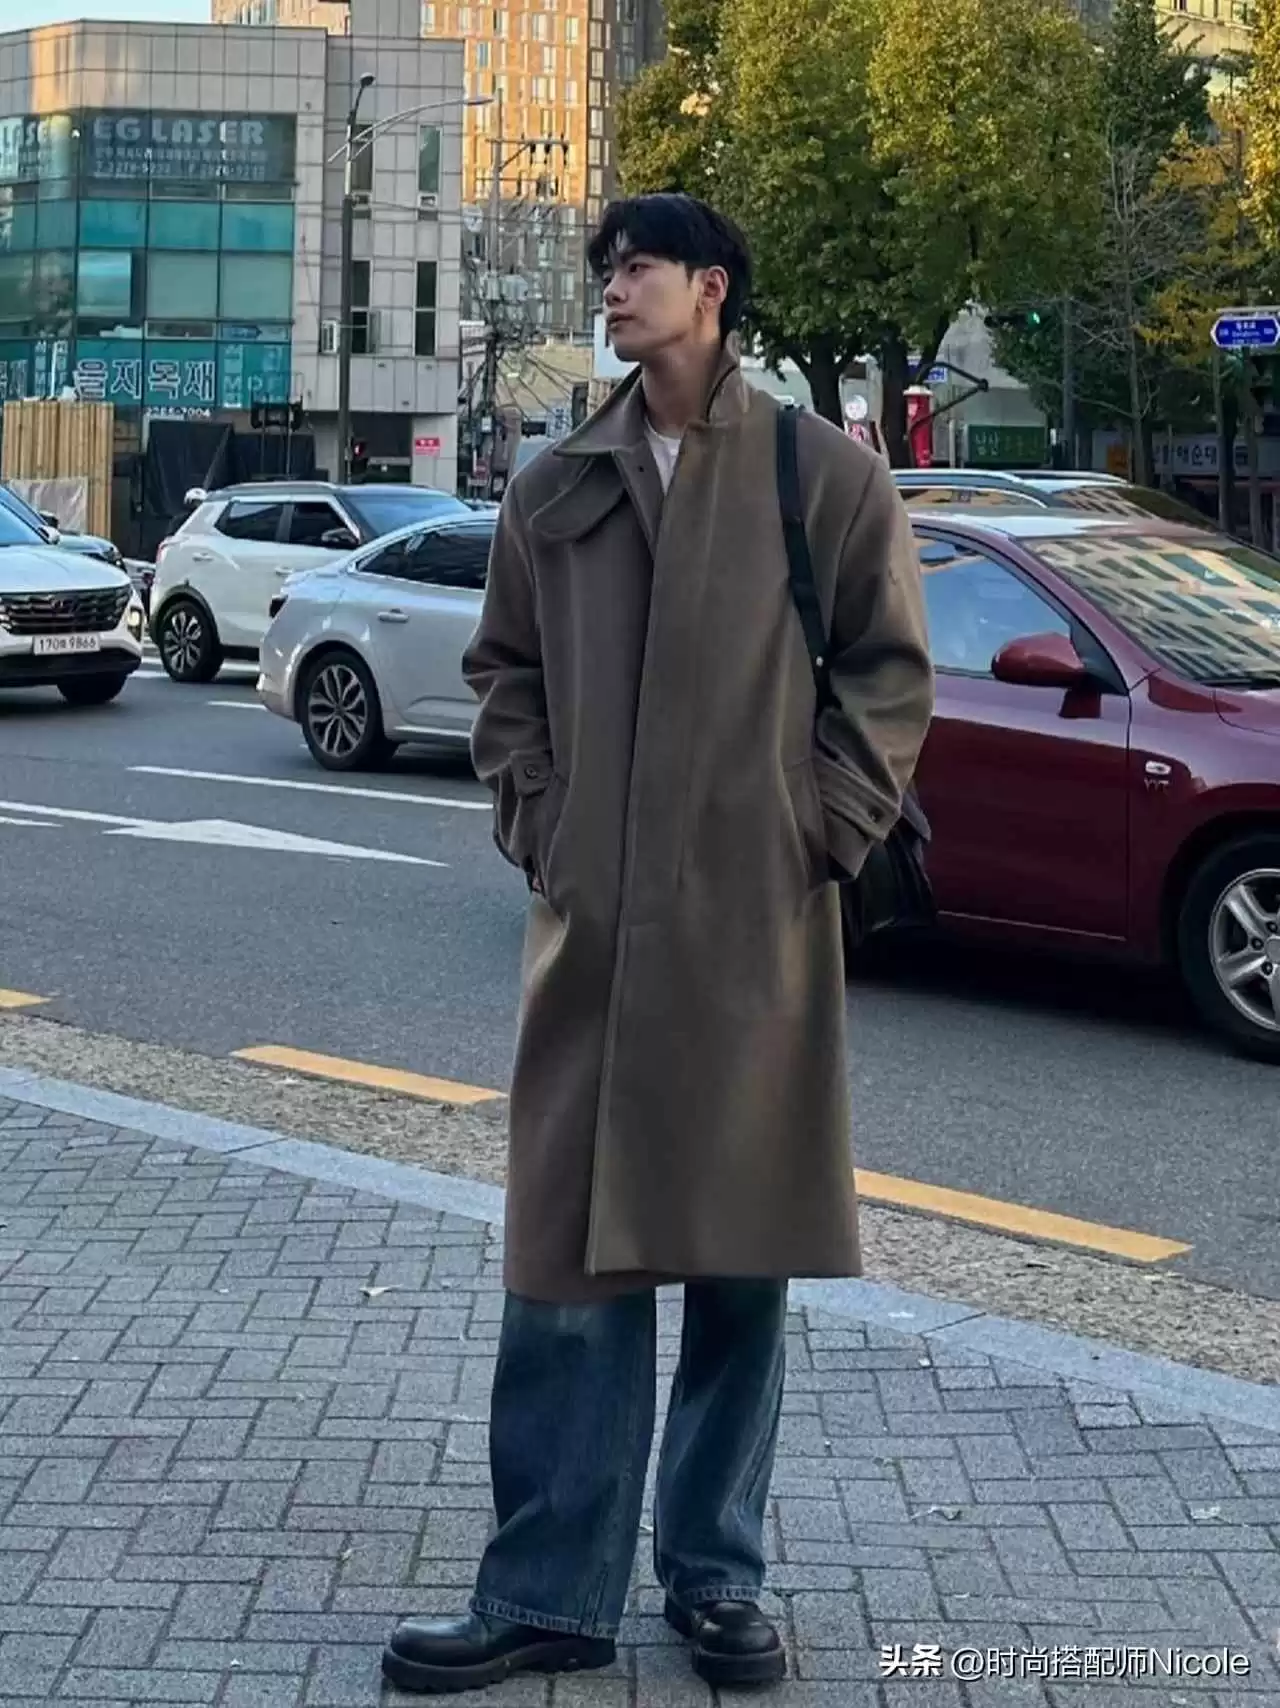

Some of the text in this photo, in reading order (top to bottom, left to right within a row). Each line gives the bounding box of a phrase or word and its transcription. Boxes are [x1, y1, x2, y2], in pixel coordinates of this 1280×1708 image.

[93, 117, 264, 145] EG LASER
[75, 358, 216, 401] 을지목재
